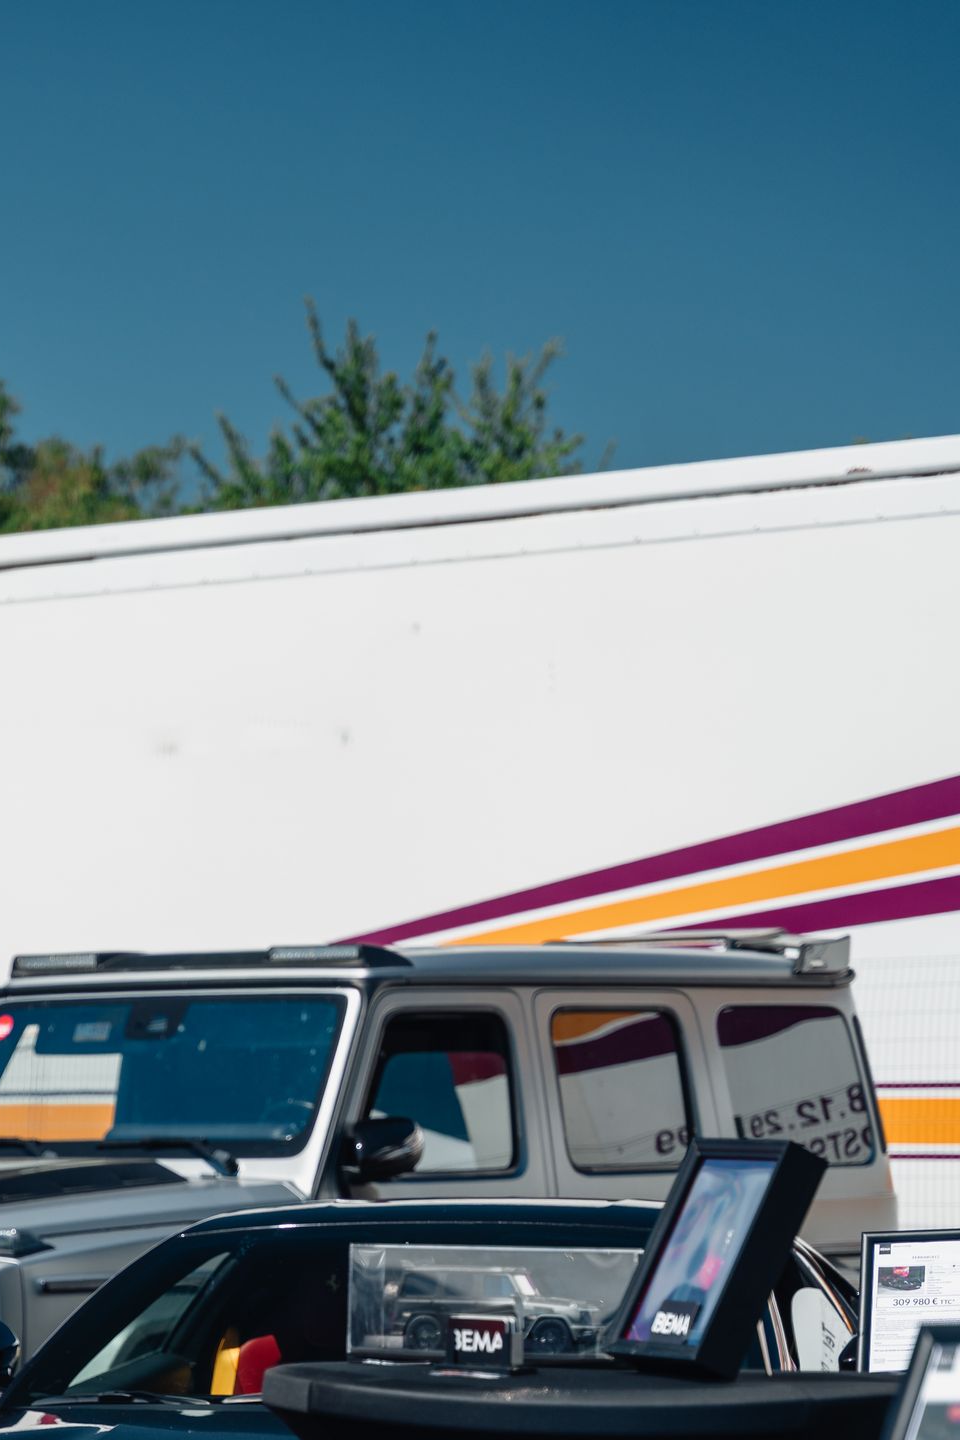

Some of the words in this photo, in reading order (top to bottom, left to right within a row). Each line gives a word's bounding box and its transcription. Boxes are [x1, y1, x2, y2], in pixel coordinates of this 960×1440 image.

[892, 1298, 911, 1307] 309
[912, 1298, 931, 1306] 980
[651, 1311, 690, 1337] BEMA
